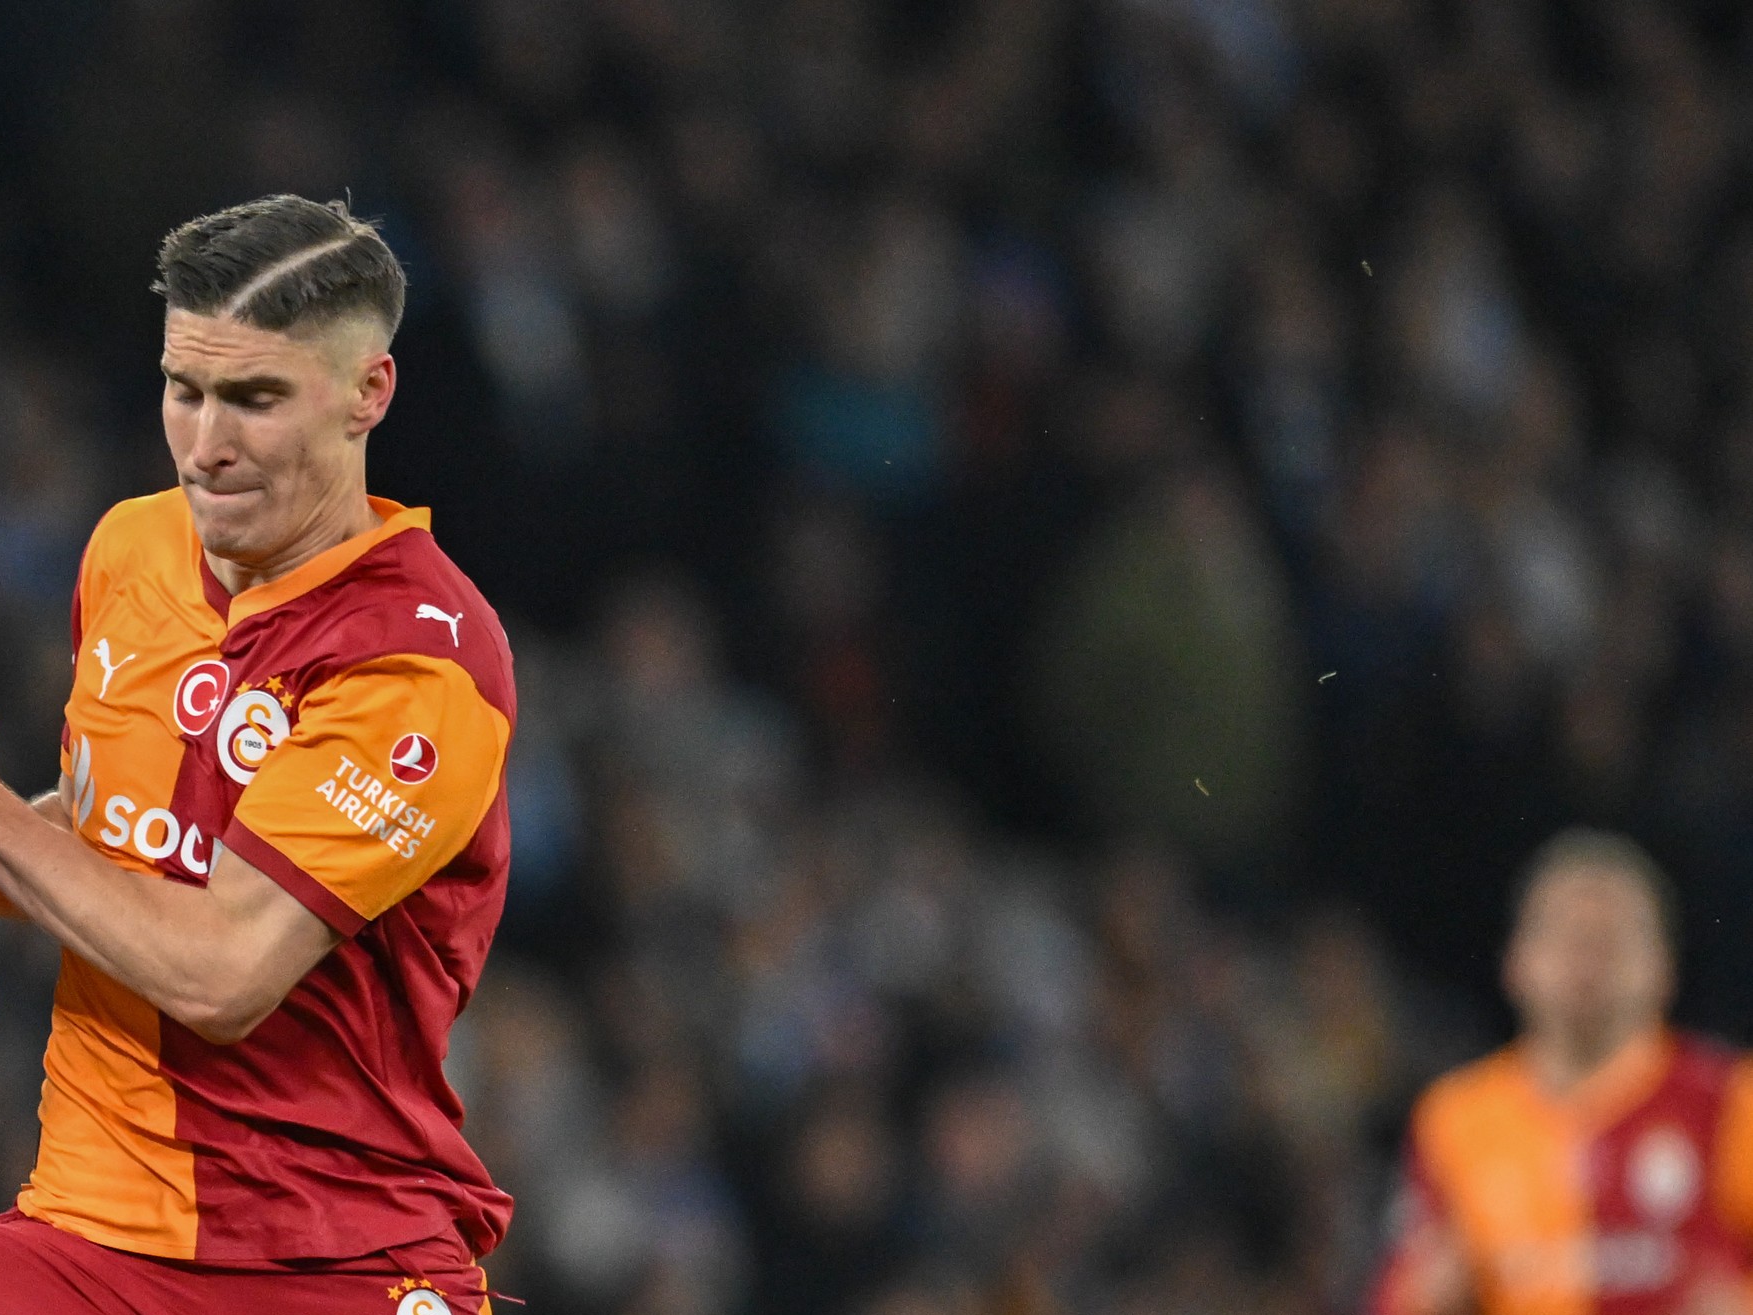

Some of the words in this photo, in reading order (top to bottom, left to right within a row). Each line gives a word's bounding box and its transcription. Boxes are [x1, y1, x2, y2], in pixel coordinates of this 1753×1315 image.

[100, 795, 223, 878] SOC
[315, 778, 421, 859] AIRLINES
[335, 755, 436, 839] TURKISH
